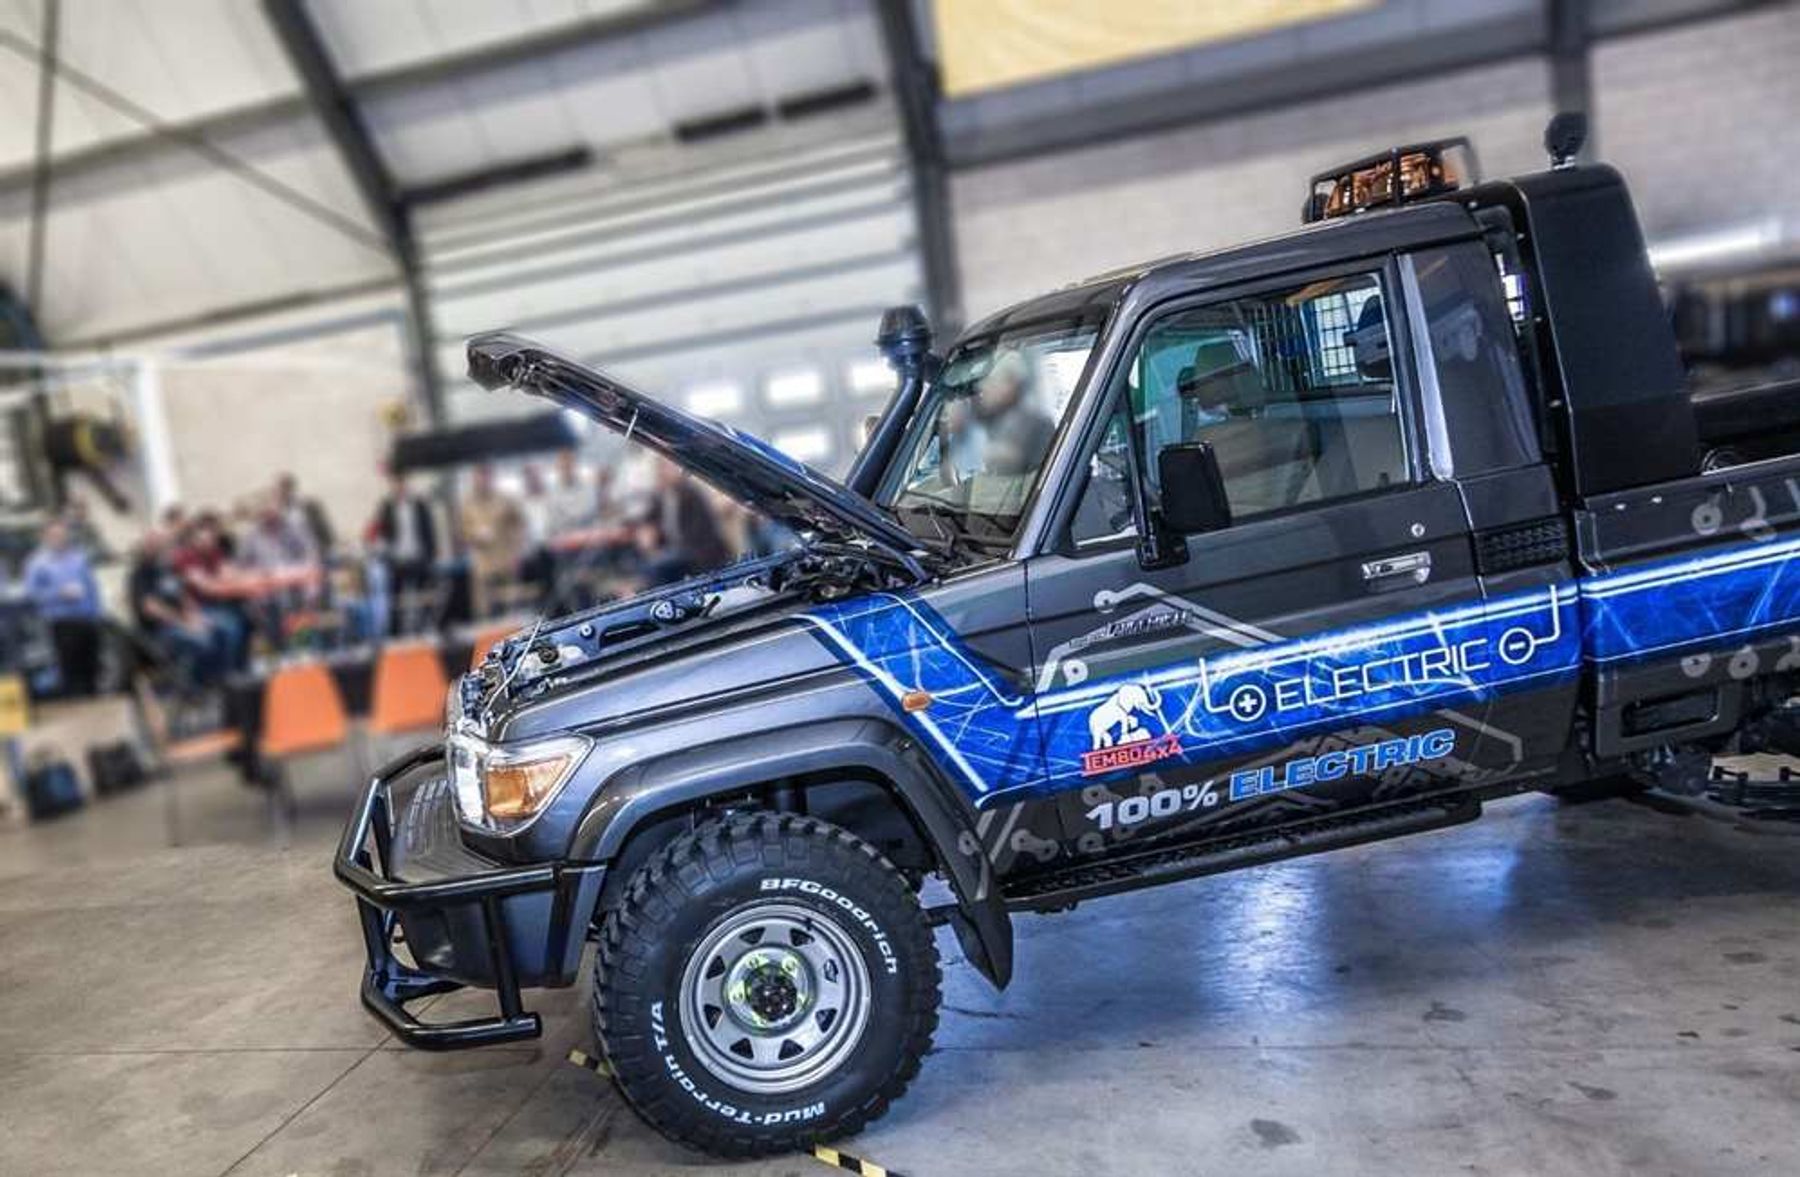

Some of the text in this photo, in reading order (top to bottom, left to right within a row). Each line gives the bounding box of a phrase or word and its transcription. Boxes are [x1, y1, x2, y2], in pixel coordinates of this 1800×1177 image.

[1276, 639, 1489, 711] ELECTRIC
[1085, 729, 1456, 829] 100% ELECTRIC
[760, 878, 897, 974] BFGoodrich
[651, 1001, 826, 1125] Mud-Terrain T/A
